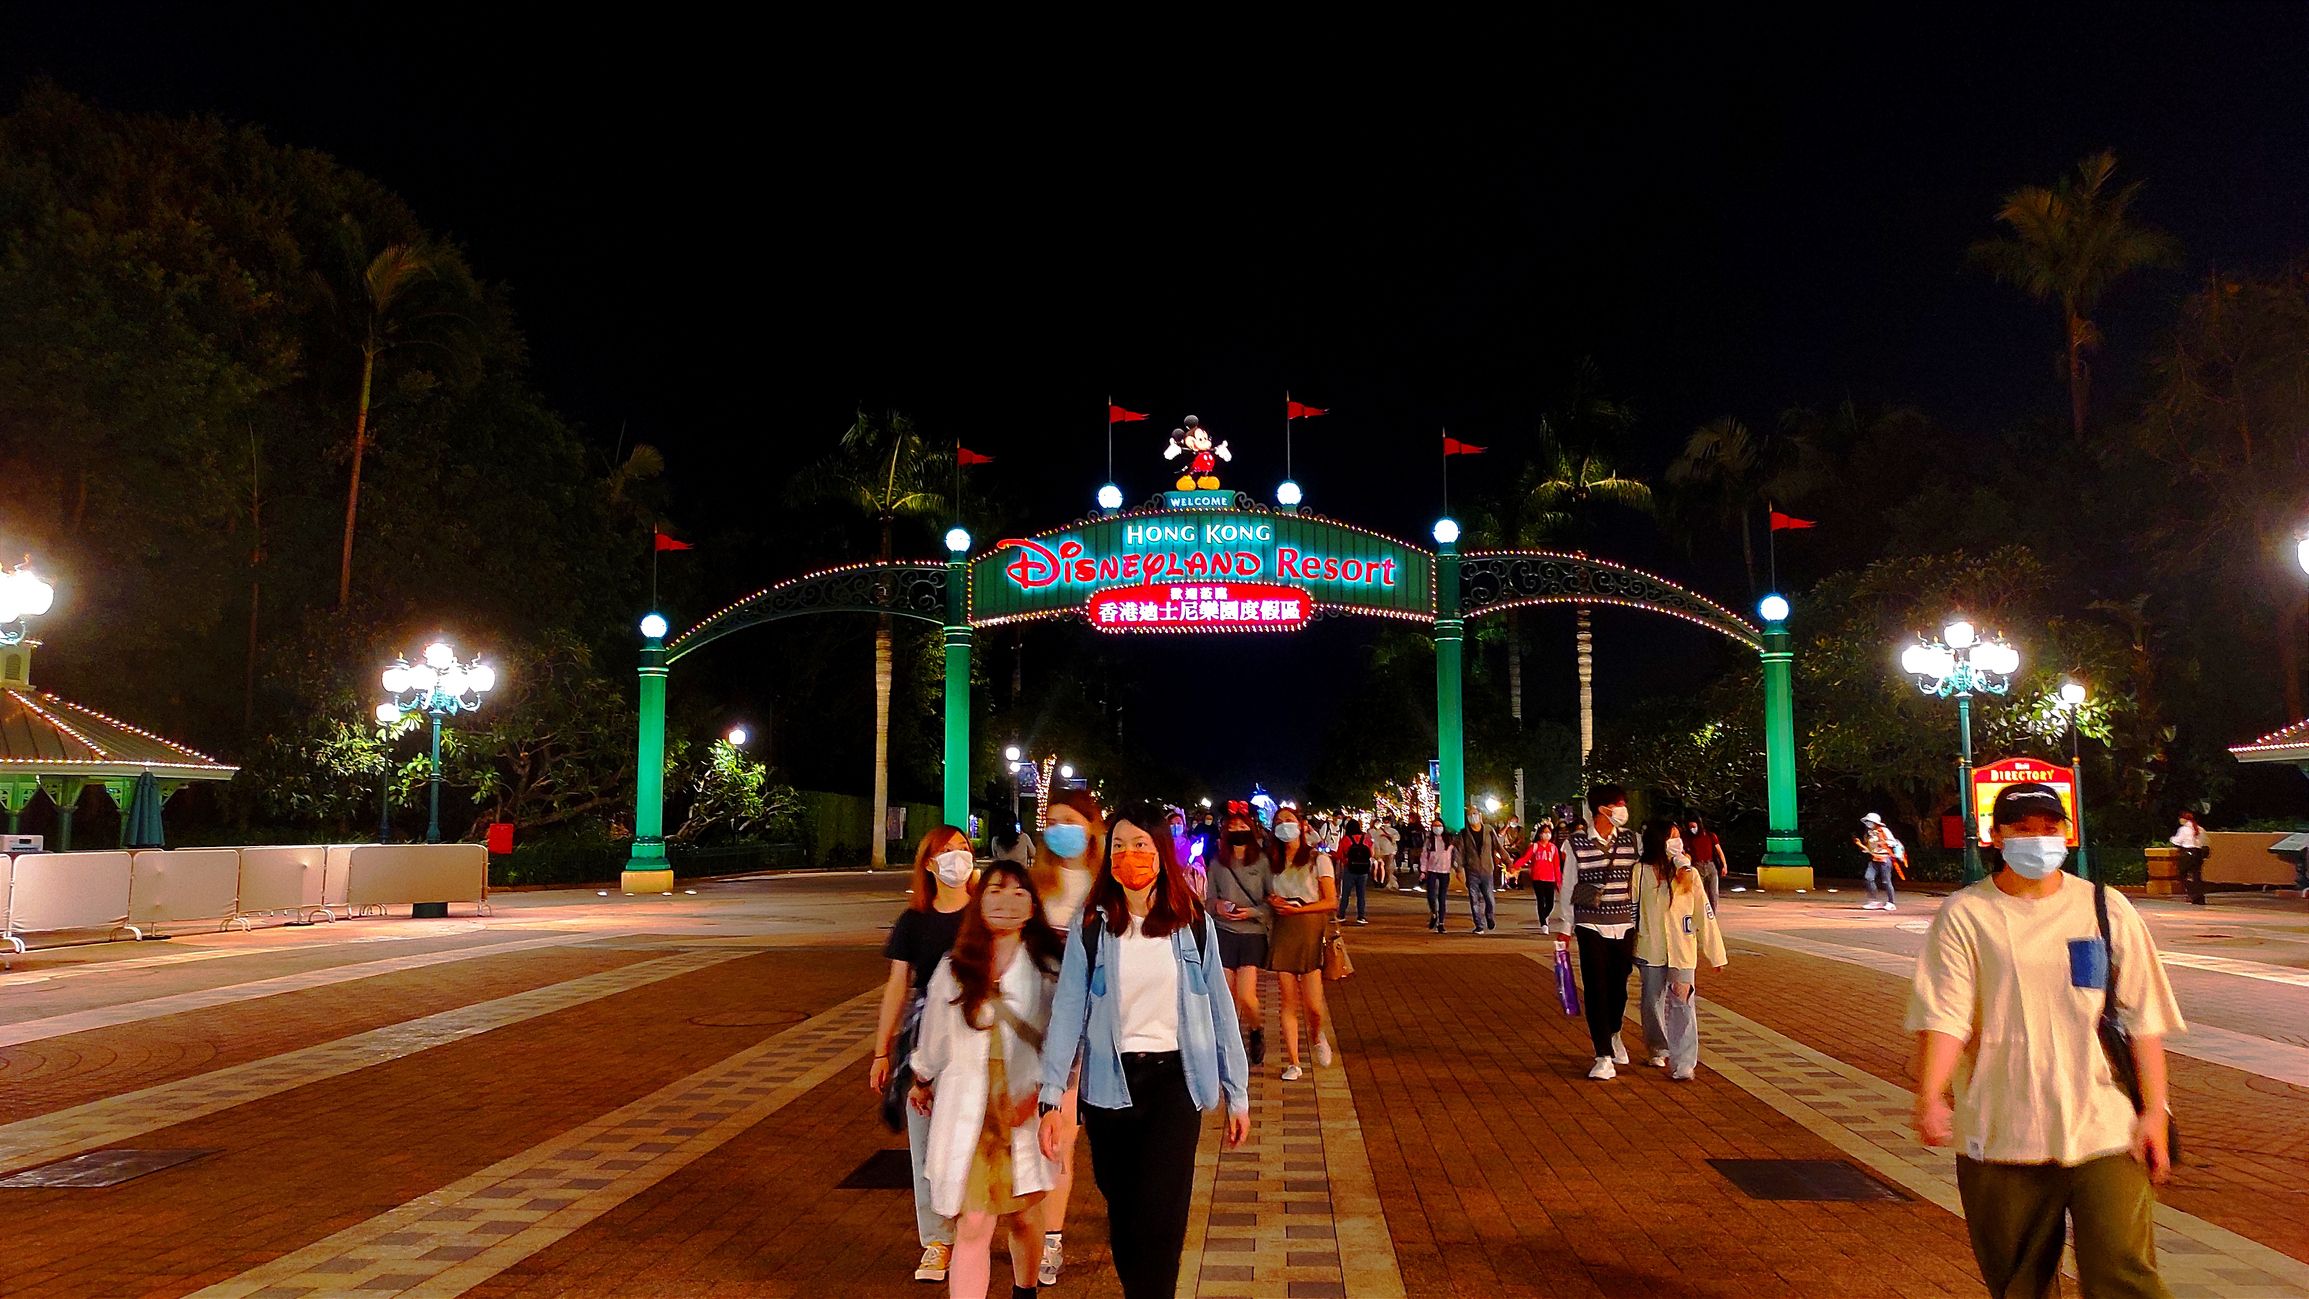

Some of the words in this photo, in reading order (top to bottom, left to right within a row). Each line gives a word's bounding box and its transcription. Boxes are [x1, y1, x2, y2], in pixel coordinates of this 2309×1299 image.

[1170, 497, 1228, 507] WELCOME
[1126, 524, 1195, 545] HONG
[1205, 523, 1271, 544] KONG
[1277, 547, 1396, 586] Resort
[1098, 600, 1301, 623] 香港迪士尼樂園度假區
[1990, 769, 2055, 781] DIRECTORY
